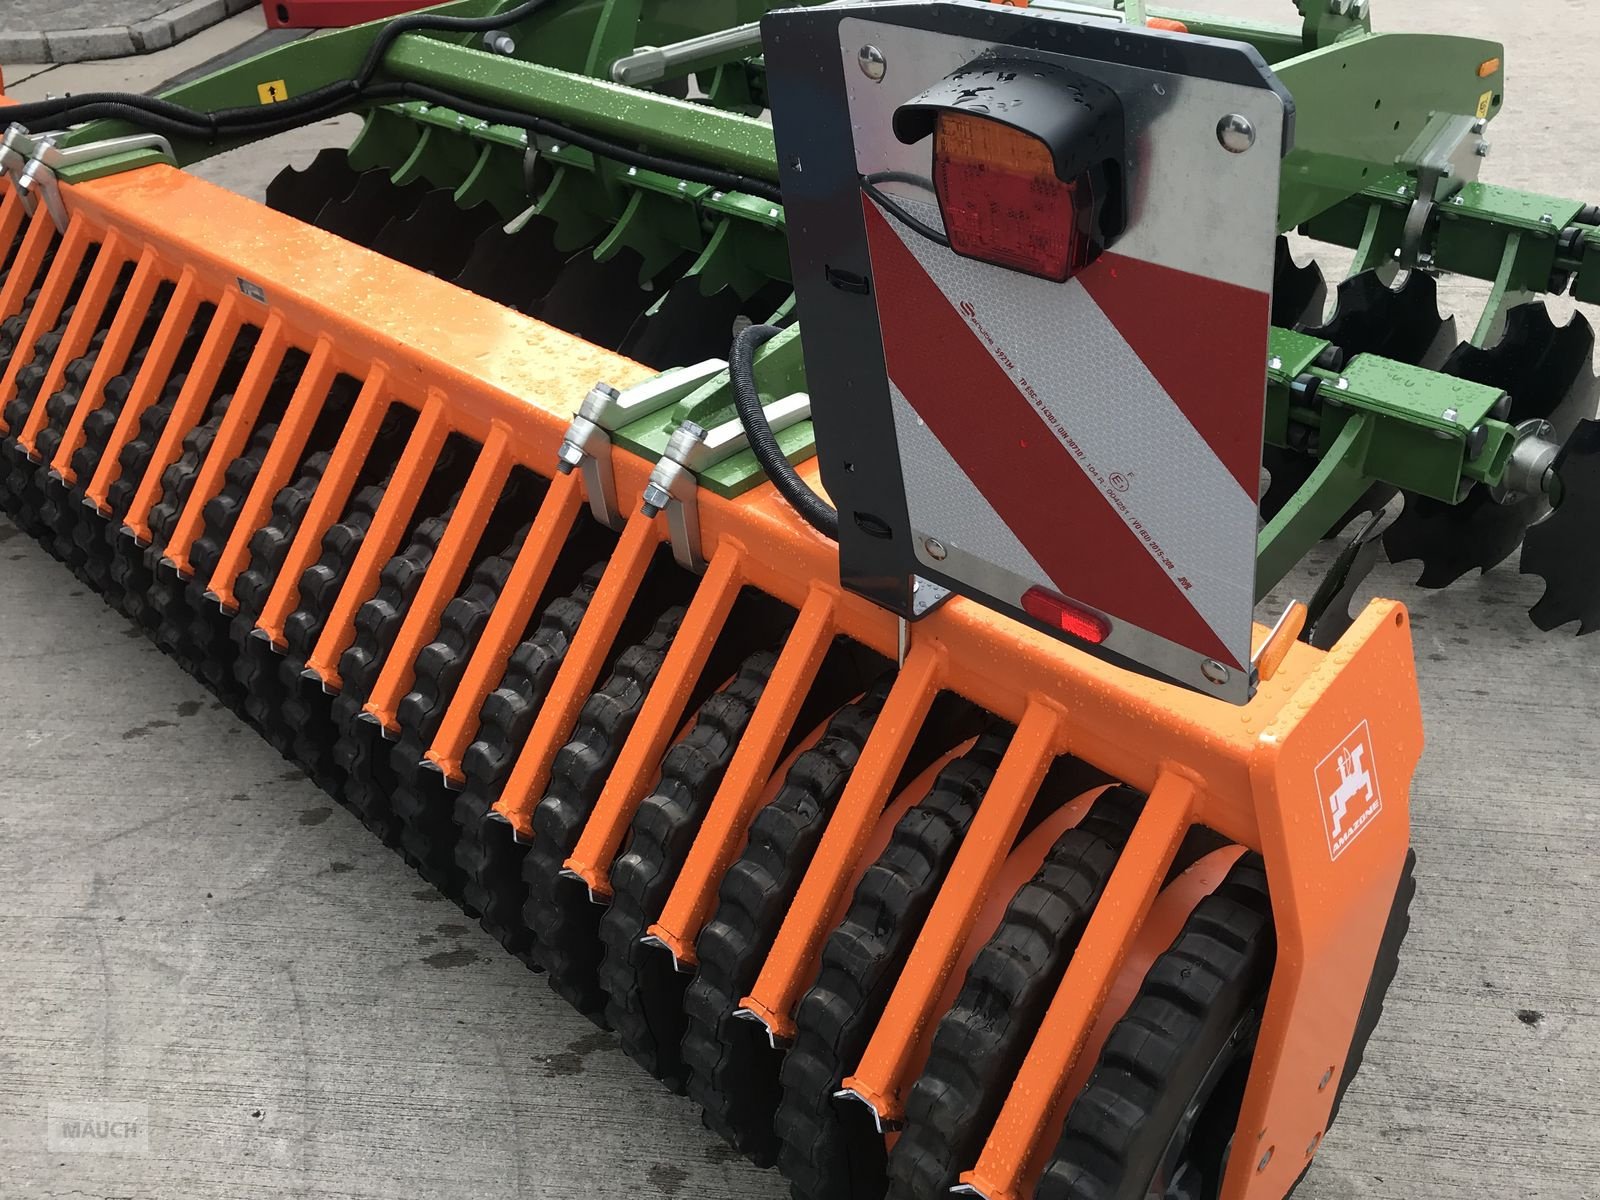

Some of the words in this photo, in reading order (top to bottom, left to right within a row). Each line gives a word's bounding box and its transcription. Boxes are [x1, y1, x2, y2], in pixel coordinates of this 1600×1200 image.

[995, 347, 1015, 370] 5921M
[1057, 427, 1069, 439] DIN
[1066, 439, 1084, 457] 30710
[1087, 463, 1099, 477] 104
[1097, 477, 1105, 485] R
[1106, 488, 1130, 515] 004251
[1140, 529, 1152, 542] (EU)
[1332, 799, 1380, 854] AMAZONE
